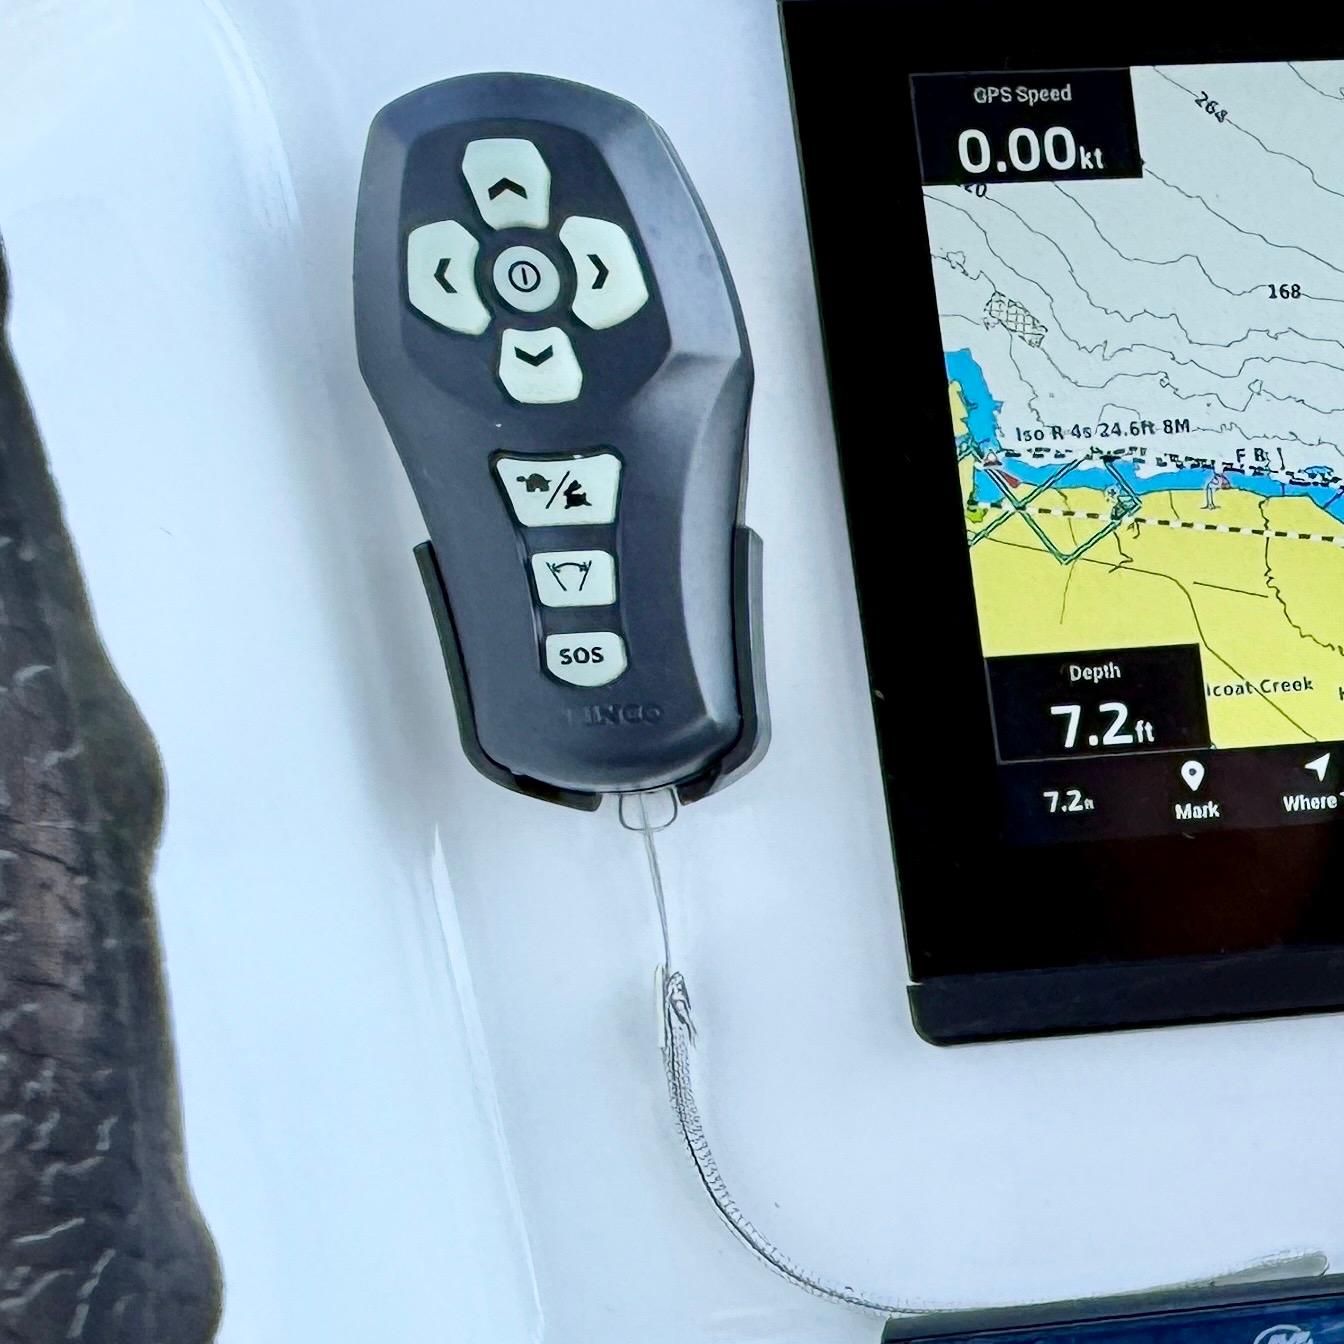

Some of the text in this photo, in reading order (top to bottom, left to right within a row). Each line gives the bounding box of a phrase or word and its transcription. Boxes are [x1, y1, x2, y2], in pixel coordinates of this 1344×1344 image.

[974, 84, 1072, 106] GPS Speed
[1268, 284, 1301, 299] 168
[1163, 418, 1191, 434] 8M
[560, 646, 604, 665] SOS
[1069, 662, 1121, 682] Depth
[1260, 678, 1314, 694] Creek
[1175, 802, 1220, 819] Mark
[1283, 794, 1337, 812] Where
